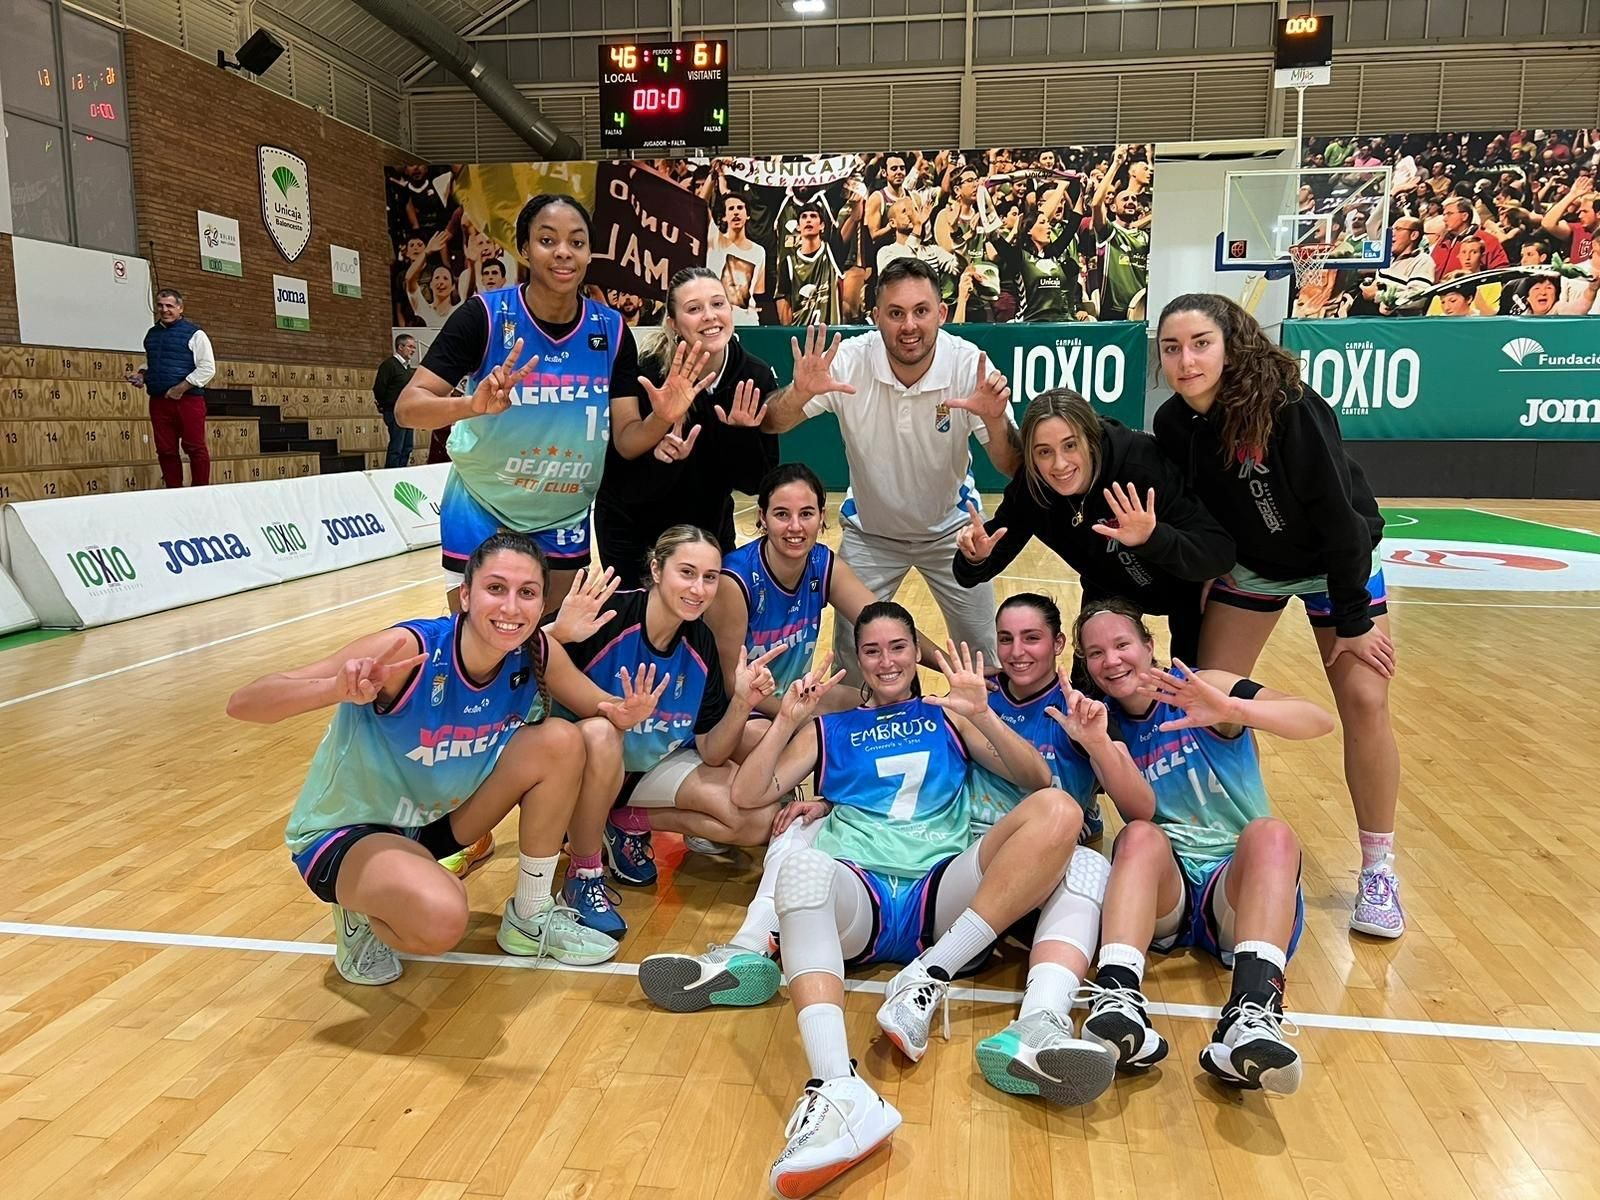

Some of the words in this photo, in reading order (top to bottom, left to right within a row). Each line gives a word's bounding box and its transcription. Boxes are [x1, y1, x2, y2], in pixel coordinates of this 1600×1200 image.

[610, 46, 636, 68] 46
[694, 42, 721, 66] 61
[658, 56, 668, 72] 4
[604, 74, 638, 83] LOCAL
[688, 70, 721, 80] VISITANTE
[633, 88, 680, 110] 00:0
[614, 112, 624, 128] 4
[713, 108, 724, 124] 4
[274, 203, 302, 220] Unicaja
[276, 218, 303, 232] Baloncesto
[1056, 338, 1082, 346] CAMPAÑA
[1346, 341, 1374, 350] CAMPAÑA
[25, 358, 34, 368] 17
[62, 360, 71, 368] 18
[94, 362, 102, 370] 19
[12, 389, 23, 399] 15
[50, 389, 60, 400] 16
[88, 390, 97, 400] 17
[118, 391, 127, 400] 18
[1520, 399, 1600, 427] Jom
[6, 433, 17, 443] 13
[46, 432, 57, 442] 14
[86, 431, 96, 441] 15
[120, 430, 130, 440] 16
[213, 429, 220, 438] 19
[240, 428, 247, 437] 20
[224, 470, 232, 479] 17
[252, 468, 259, 477] 18
[278, 466, 285, 475] 19
[302, 464, 309, 472] 20
[44, 483, 56, 495] 12
[86, 480, 97, 491] 13
[126, 477, 136, 488] 14
[514, 477, 540, 490] FIT
[544, 482, 580, 494] CLUB
[850, 717, 937, 747] EMBRUJO
[875, 750, 930, 821] 7
